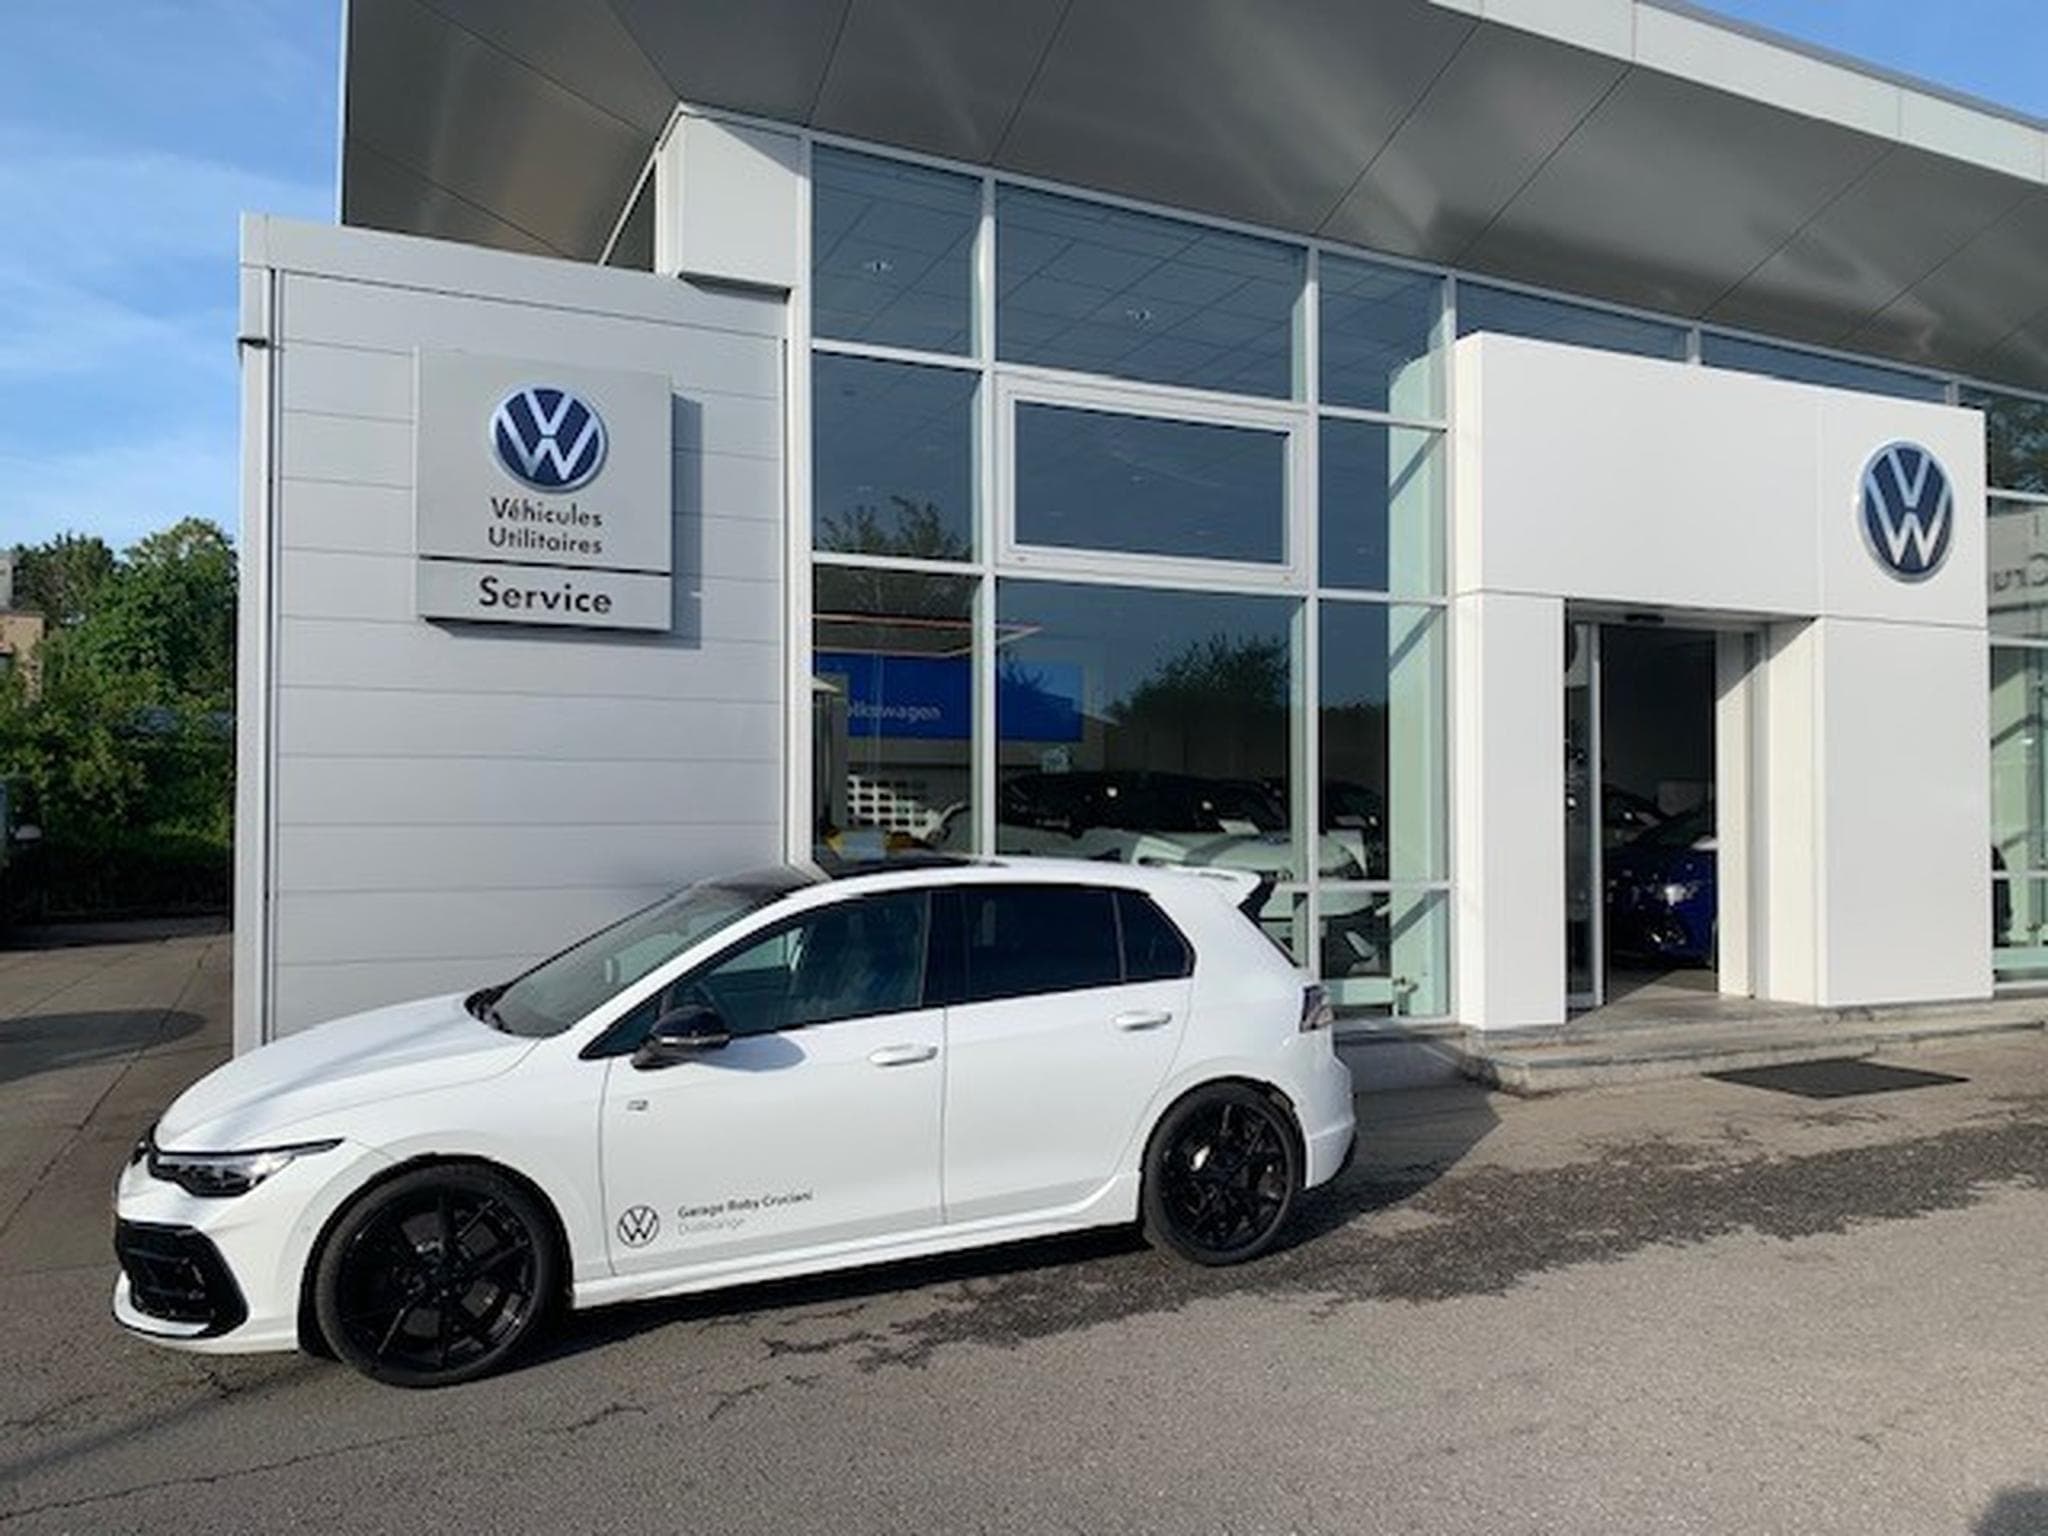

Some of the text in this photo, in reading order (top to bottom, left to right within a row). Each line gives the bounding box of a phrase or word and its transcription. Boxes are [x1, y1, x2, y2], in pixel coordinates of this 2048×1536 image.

[490, 497, 603, 527] Véhicules
[488, 527, 603, 554] Utilitaires
[478, 575, 612, 614] Service
[678, 1204, 724, 1219] Garage
